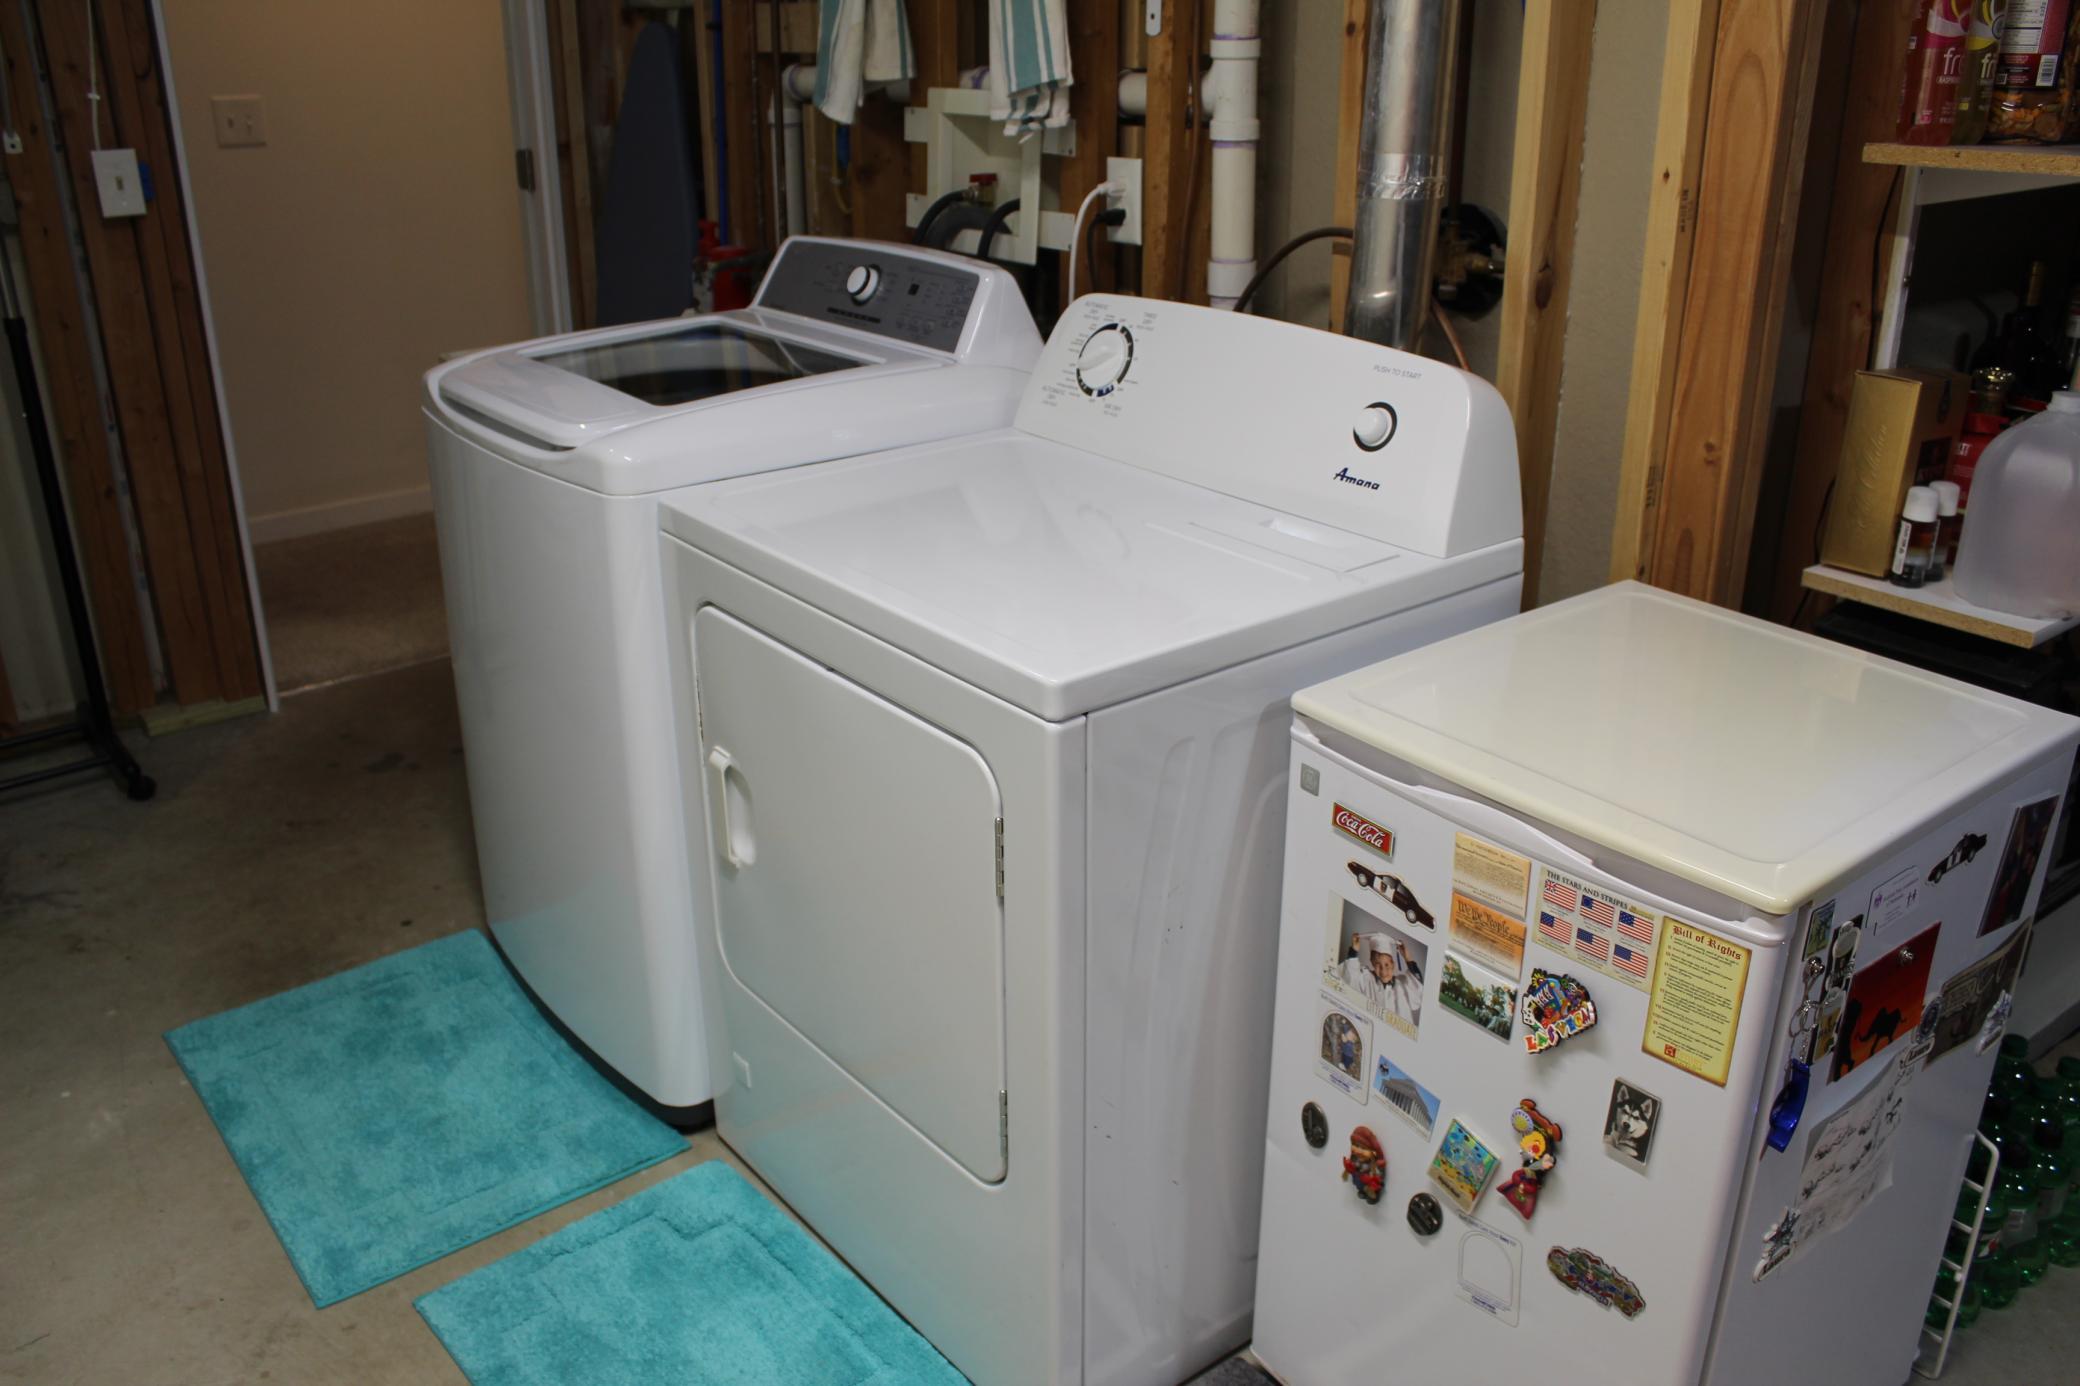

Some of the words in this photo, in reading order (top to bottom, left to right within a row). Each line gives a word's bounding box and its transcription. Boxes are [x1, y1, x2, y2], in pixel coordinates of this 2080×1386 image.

[1401, 370, 1423, 379] START
[1332, 466, 1382, 491] Amana
[1547, 869, 1561, 881] THE
[1562, 875, 1582, 890] STARS
[1582, 886, 1600, 898] AND
[1600, 892, 1628, 911] STRIPES
[1672, 925, 1693, 940] Bill
[1695, 935, 1705, 944] of
[1707, 939, 1742, 961] Rights
[1523, 1023, 1559, 1053] LAS
